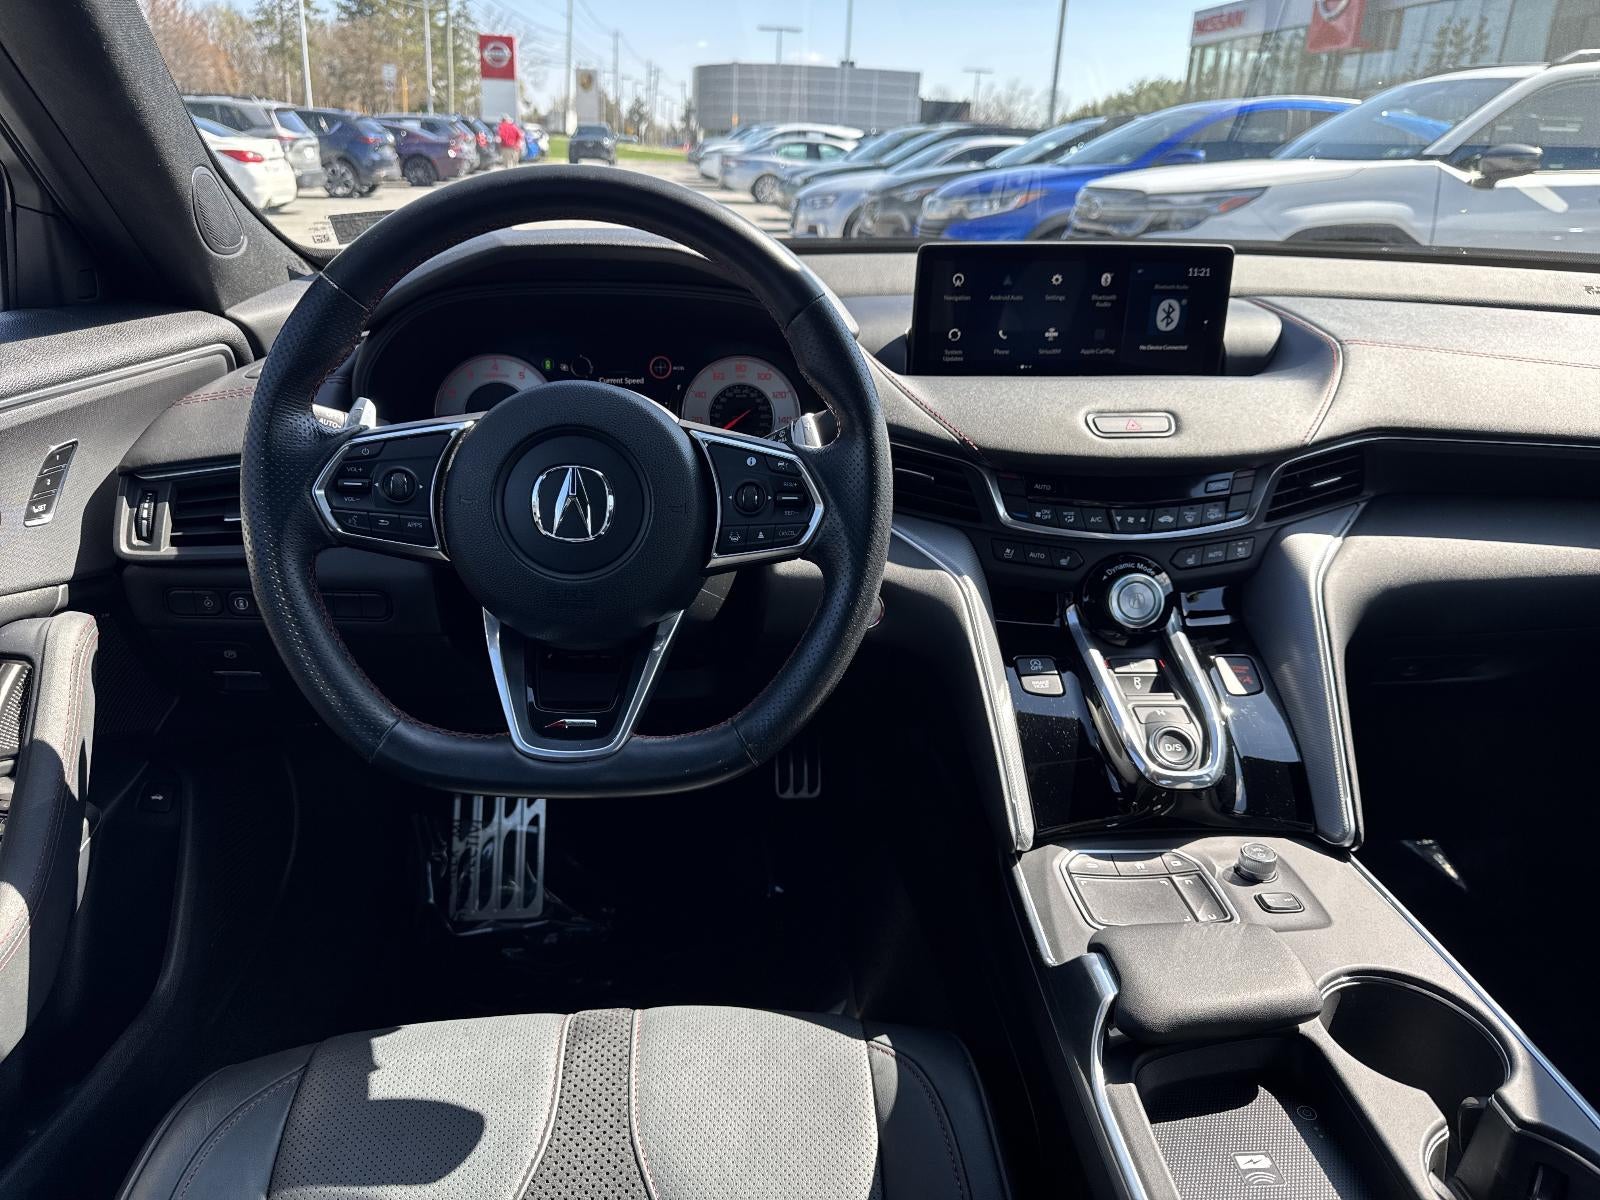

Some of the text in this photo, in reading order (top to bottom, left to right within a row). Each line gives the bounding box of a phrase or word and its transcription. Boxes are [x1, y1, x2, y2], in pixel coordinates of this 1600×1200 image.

[1194, 11, 1246, 34] NISSAN
[1188, 267, 1211, 277] 11:21
[943, 294, 971, 302] Navigation
[1045, 294, 1066, 302] Settings
[599, 377, 645, 386] Current Speed
[319, 418, 337, 428] AUTO
[1029, 551, 1045, 559] AUTO
[1105, 562, 1155, 576] Dynamic Mode
[1164, 743, 1182, 752] D/S
